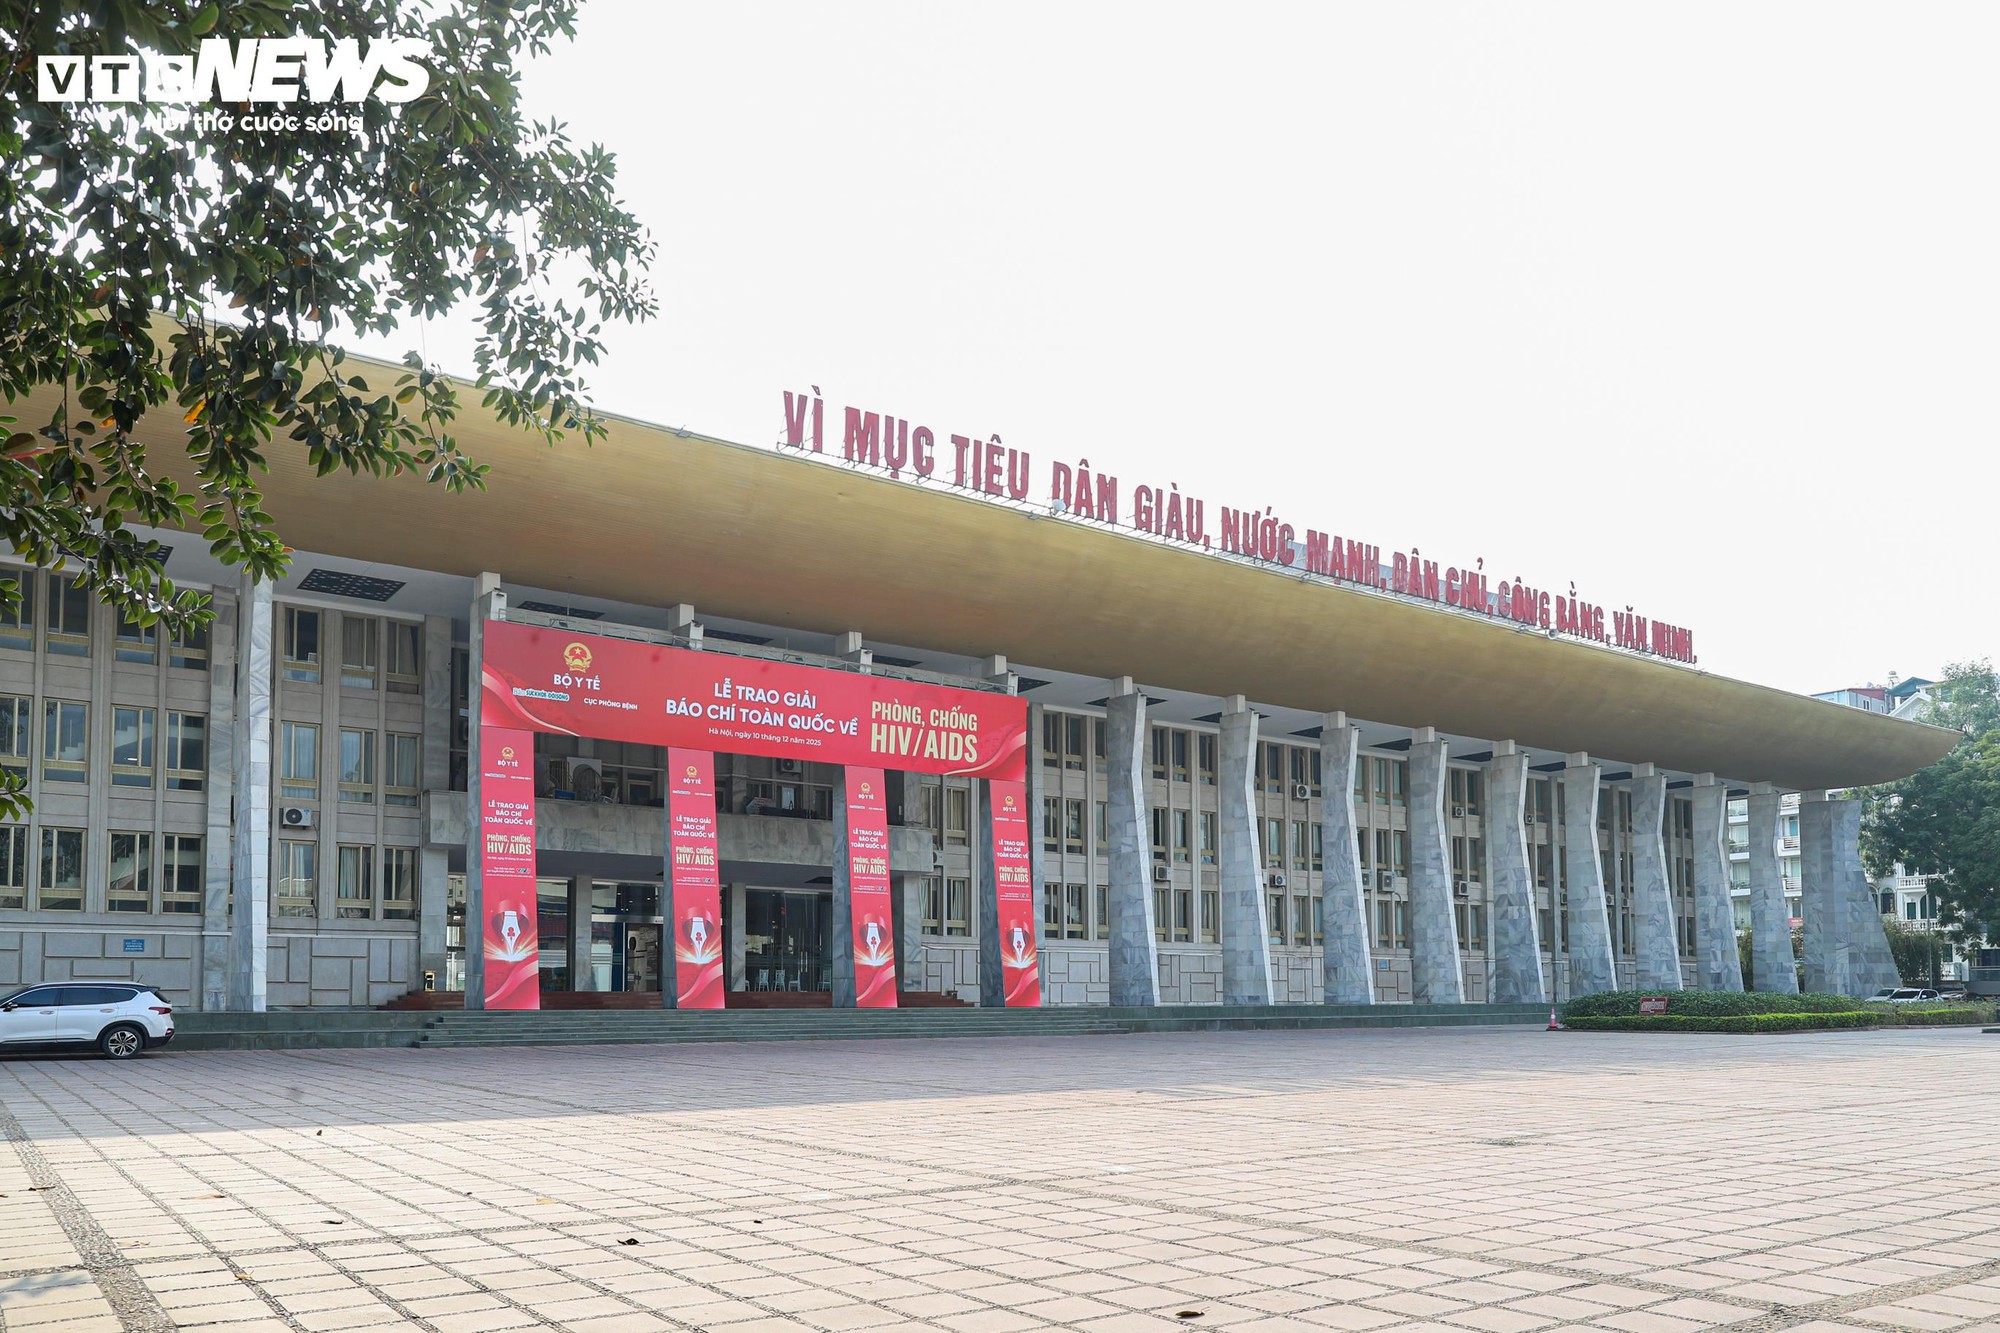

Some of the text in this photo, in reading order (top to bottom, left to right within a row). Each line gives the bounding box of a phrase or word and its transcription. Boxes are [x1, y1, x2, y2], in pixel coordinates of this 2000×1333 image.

[783, 385, 823, 454] VÌ
[844, 406, 934, 479] MỤC
[951, 434, 1029, 500] TIÊU
[1052, 458, 1117, 524] DÂN
[1134, 482, 1210, 551] GIÀU,
[1221, 506, 1295, 565] NƯỚC
[1306, 529, 1387, 592] MẠNH,
[1392, 548, 1439, 601] DÂN
[1445, 557, 1494, 619] CHỦ,
[1498, 576, 1550, 630] CÔNG
[1613, 605, 1647, 652] VĂN
[553, 673, 601, 690] BỘ Y TẾ
[714, 678, 816, 709] LỄ TRAO GIẢI
[666, 698, 859, 736] BÁO CHÍ TOÀN QUỐC VỀ
[872, 699, 978, 731] PHÒNG, CHỐNG
[720, 728, 733, 736] Nội,
[734, 731, 752, 739] ngày
[761, 733, 781, 743] tháng
[871, 723, 978, 763] HIV/AIDS
[487, 842, 532, 855] HIV/AIDS
[676, 854, 714, 865] HIV/AIDS
[854, 864, 886, 874] HIV/AIDS
[1000, 873, 1028, 882] HIV/AIDS
